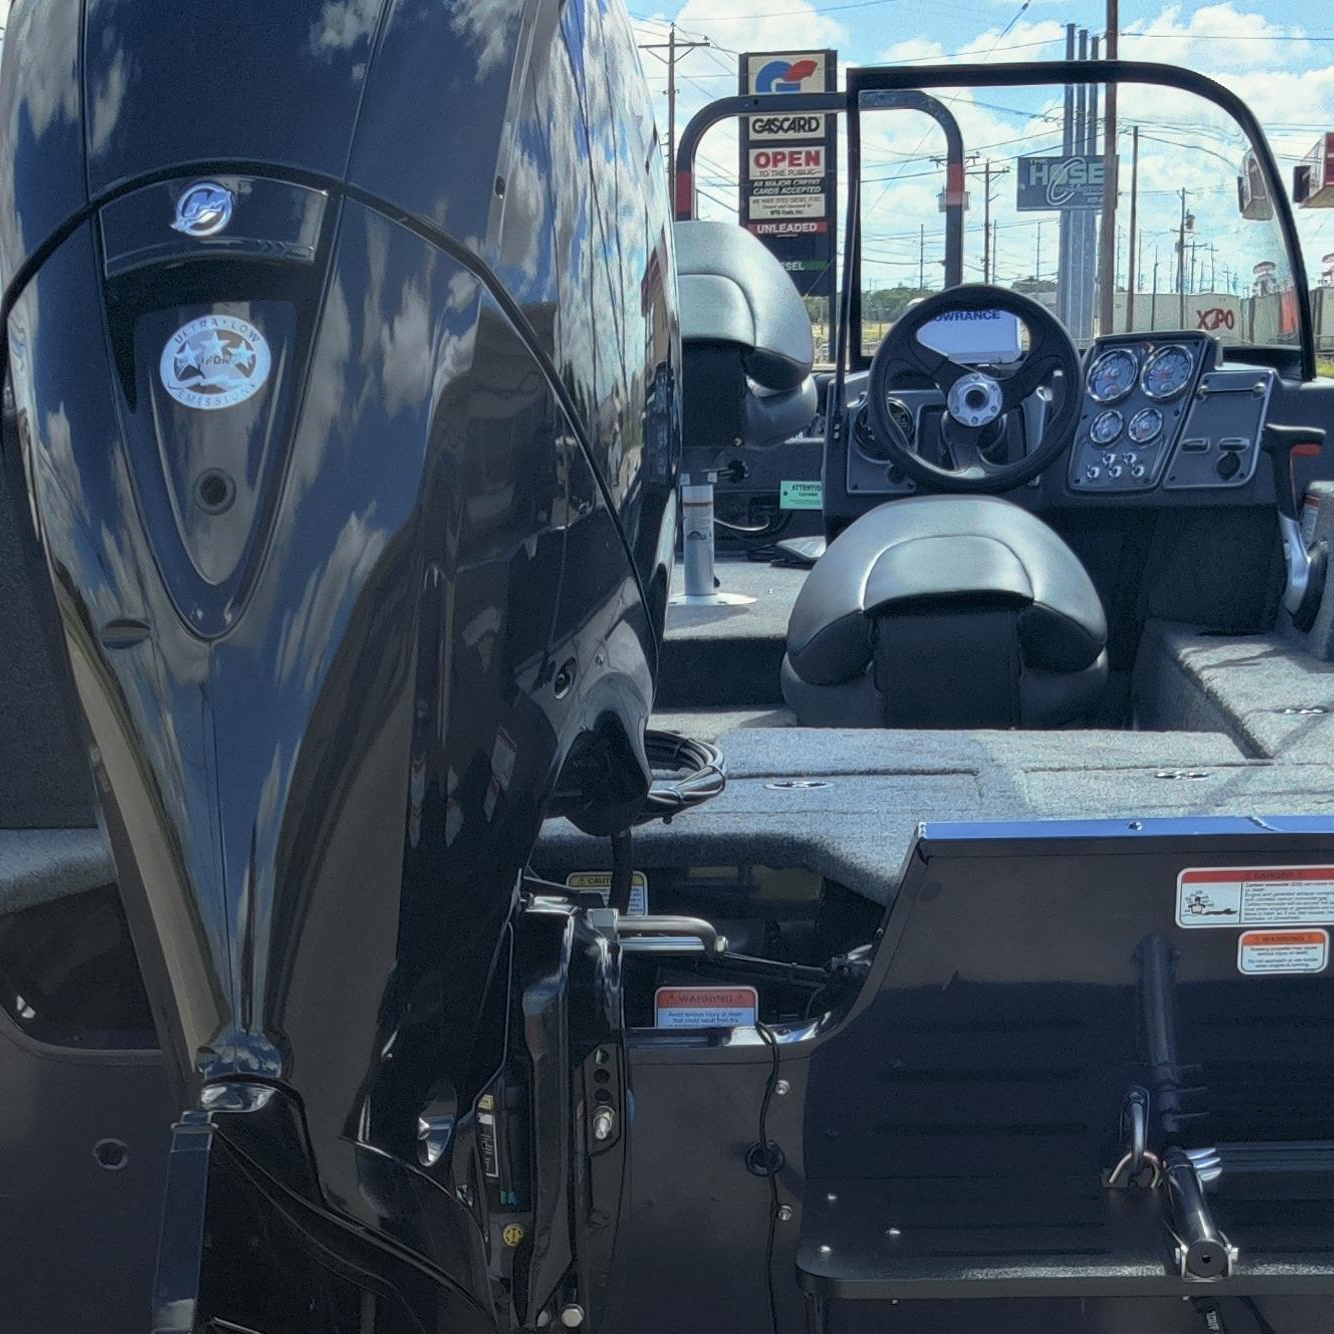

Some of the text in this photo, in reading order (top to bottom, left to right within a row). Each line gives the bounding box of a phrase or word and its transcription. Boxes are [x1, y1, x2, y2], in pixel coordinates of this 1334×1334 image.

[752, 117, 820, 134] GASCARD
[754, 151, 821, 169] OPEN
[1029, 163, 1104, 186] HOSE
[781, 186, 821, 194] ACCEPTED
[757, 223, 817, 233] UNLEADED
[782, 262, 805, 271] SEL
